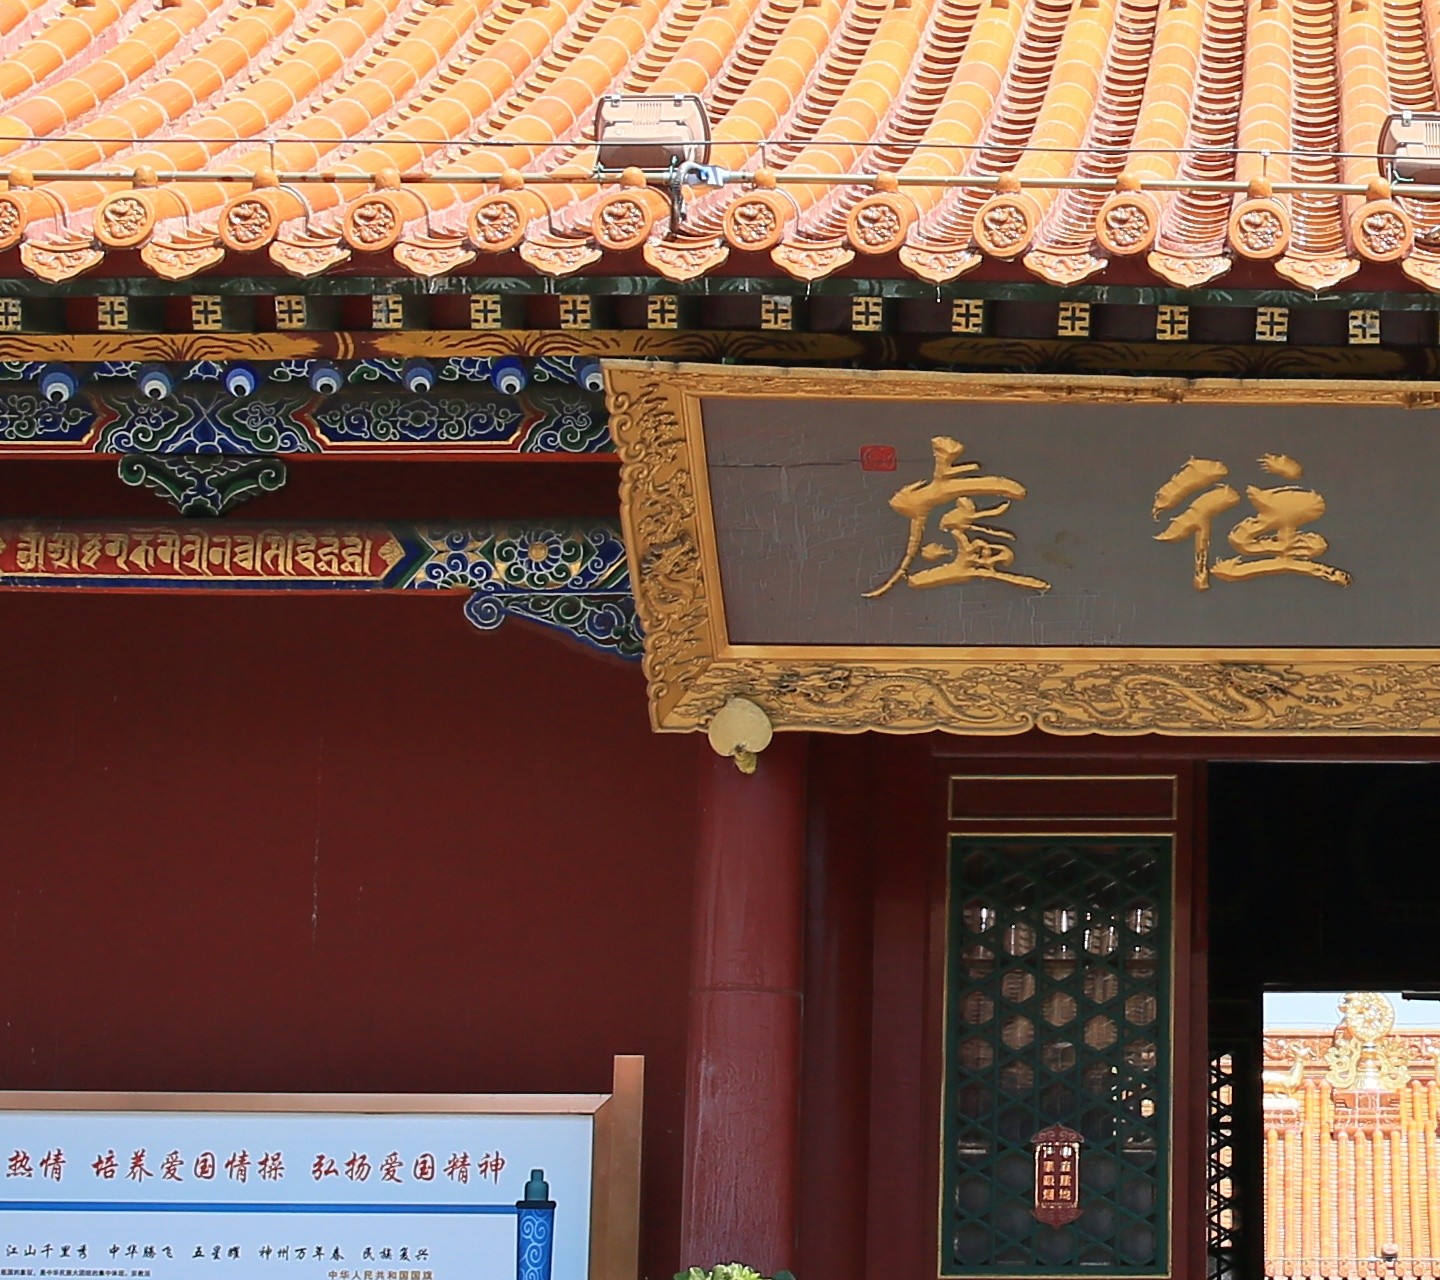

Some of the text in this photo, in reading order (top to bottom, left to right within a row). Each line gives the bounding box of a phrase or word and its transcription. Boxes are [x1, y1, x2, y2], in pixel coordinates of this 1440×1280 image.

[90, 1150, 287, 1184] 培养爱国情操
[310, 1151, 508, 1187] 弘扬爱国精神
[6, 1244, 90, 1260] 江山千里秀
[109, 1245, 175, 1260] 中华腾飞
[192, 1245, 243, 1261] 五星耀
[258, 1245, 346, 1262] 神州万年春
[362, 1246, 430, 1262] 民族复兴
[328, 1269, 433, 1280] 中华人民共和国国旗
